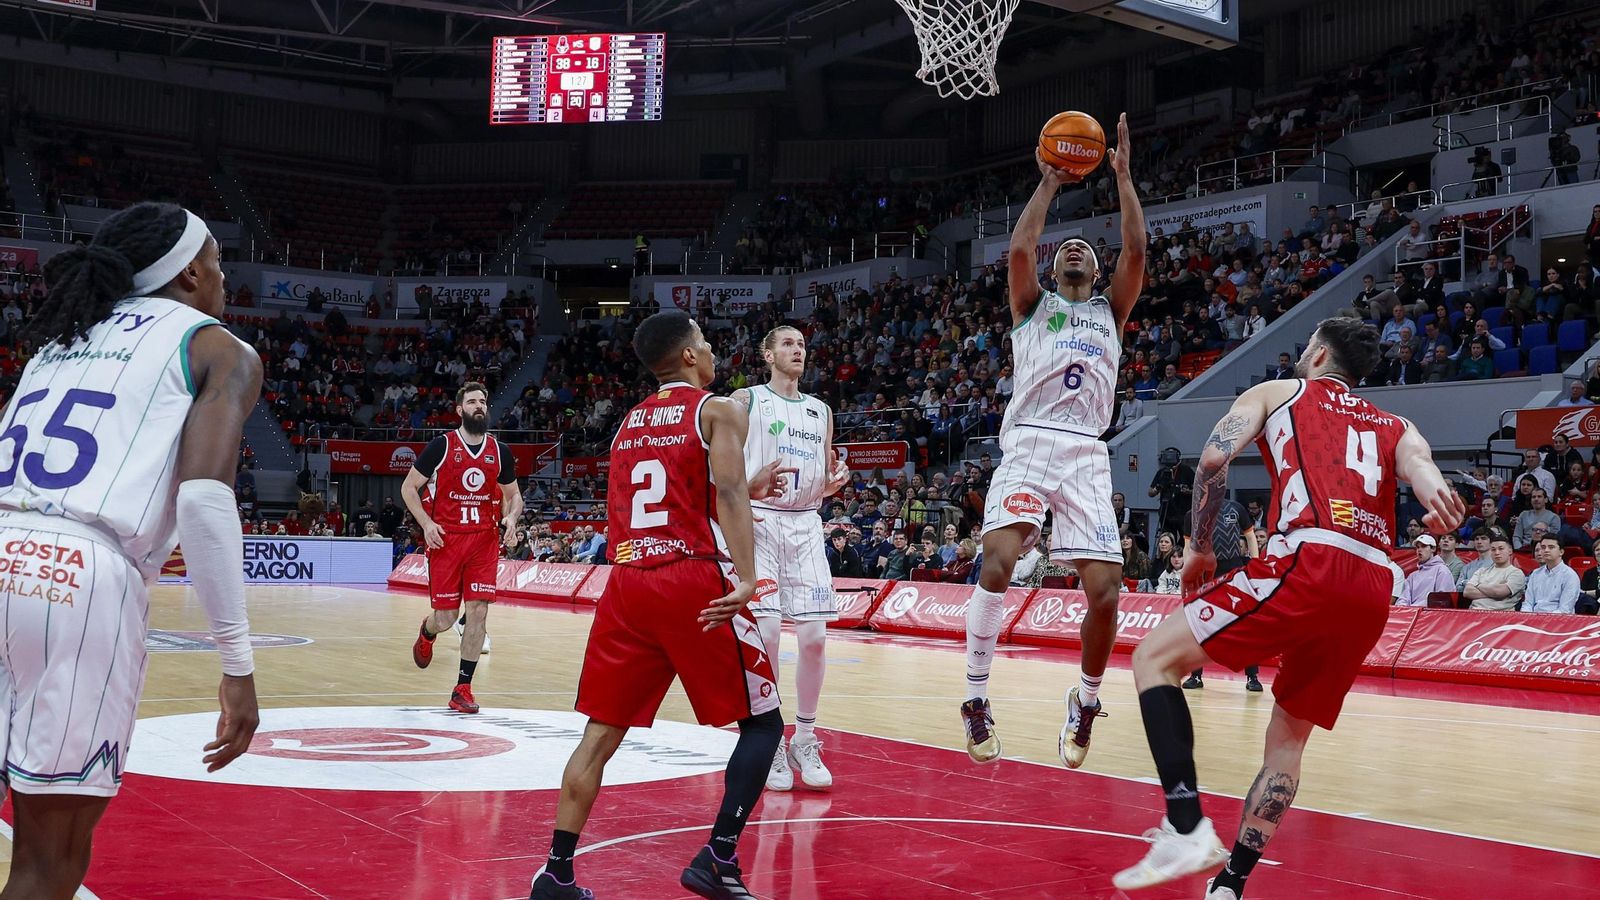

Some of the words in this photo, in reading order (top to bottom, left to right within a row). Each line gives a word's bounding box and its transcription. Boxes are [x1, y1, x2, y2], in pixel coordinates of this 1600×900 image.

[556, 58, 570, 69] 38
[586, 57, 599, 69] 16
[553, 111, 559, 120] 2
[593, 111, 598, 120] 4
[1056, 140, 1099, 158] Wilson
[1149, 201, 1262, 228] www.zaragozadeporte.com
[293, 283, 365, 304] CaaBank
[437, 286, 490, 300] Zaragoza
[696, 285, 753, 300] Zaragoza
[1070, 316, 1110, 338] Unicaja
[1055, 336, 1103, 356] málaga
[1064, 363, 1085, 389] 6
[0, 388, 116, 490] 55
[617, 440, 632, 451] AIR
[634, 434, 688, 448] HORIZONT
[788, 427, 822, 444] Unicaja
[778, 444, 815, 461] málaga
[1346, 424, 1382, 497] 4
[630, 459, 668, 529] 2
[460, 507, 480, 524] 14
[5, 540, 84, 569] COSTA
[243, 542, 299, 560] ERNO
[37, 565, 80, 589] SOL
[243, 561, 313, 579] RAGON
[1460, 641, 1600, 668] Campodulce
